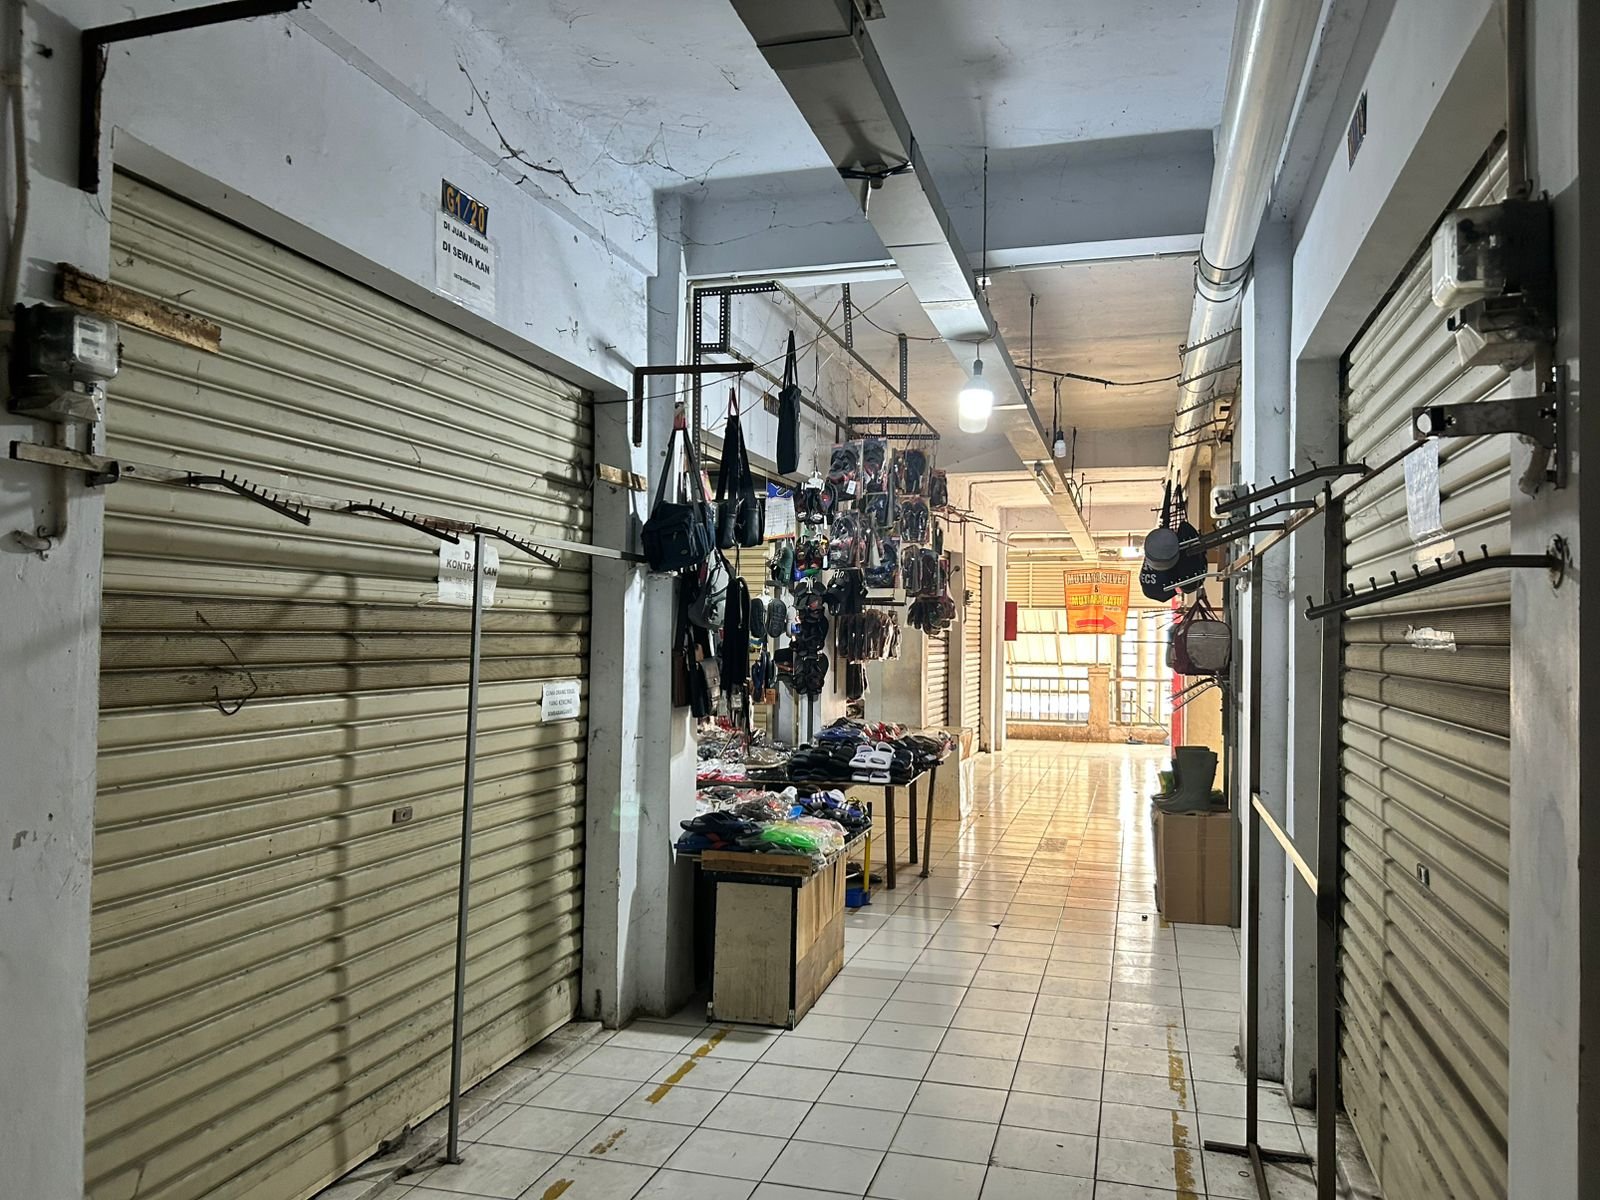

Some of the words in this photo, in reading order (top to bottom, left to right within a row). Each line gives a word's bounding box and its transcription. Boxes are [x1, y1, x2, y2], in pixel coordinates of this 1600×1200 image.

[446, 185, 485, 233] G1/20
[443, 220, 451, 231] DI
[452, 227, 467, 241] JUAL
[468, 234, 489, 254] MURAH
[442, 240, 451, 253] DI
[452, 246, 474, 266] SEWA
[475, 258, 490, 275] KAN
[1101, 572, 1128, 585] SILVER
